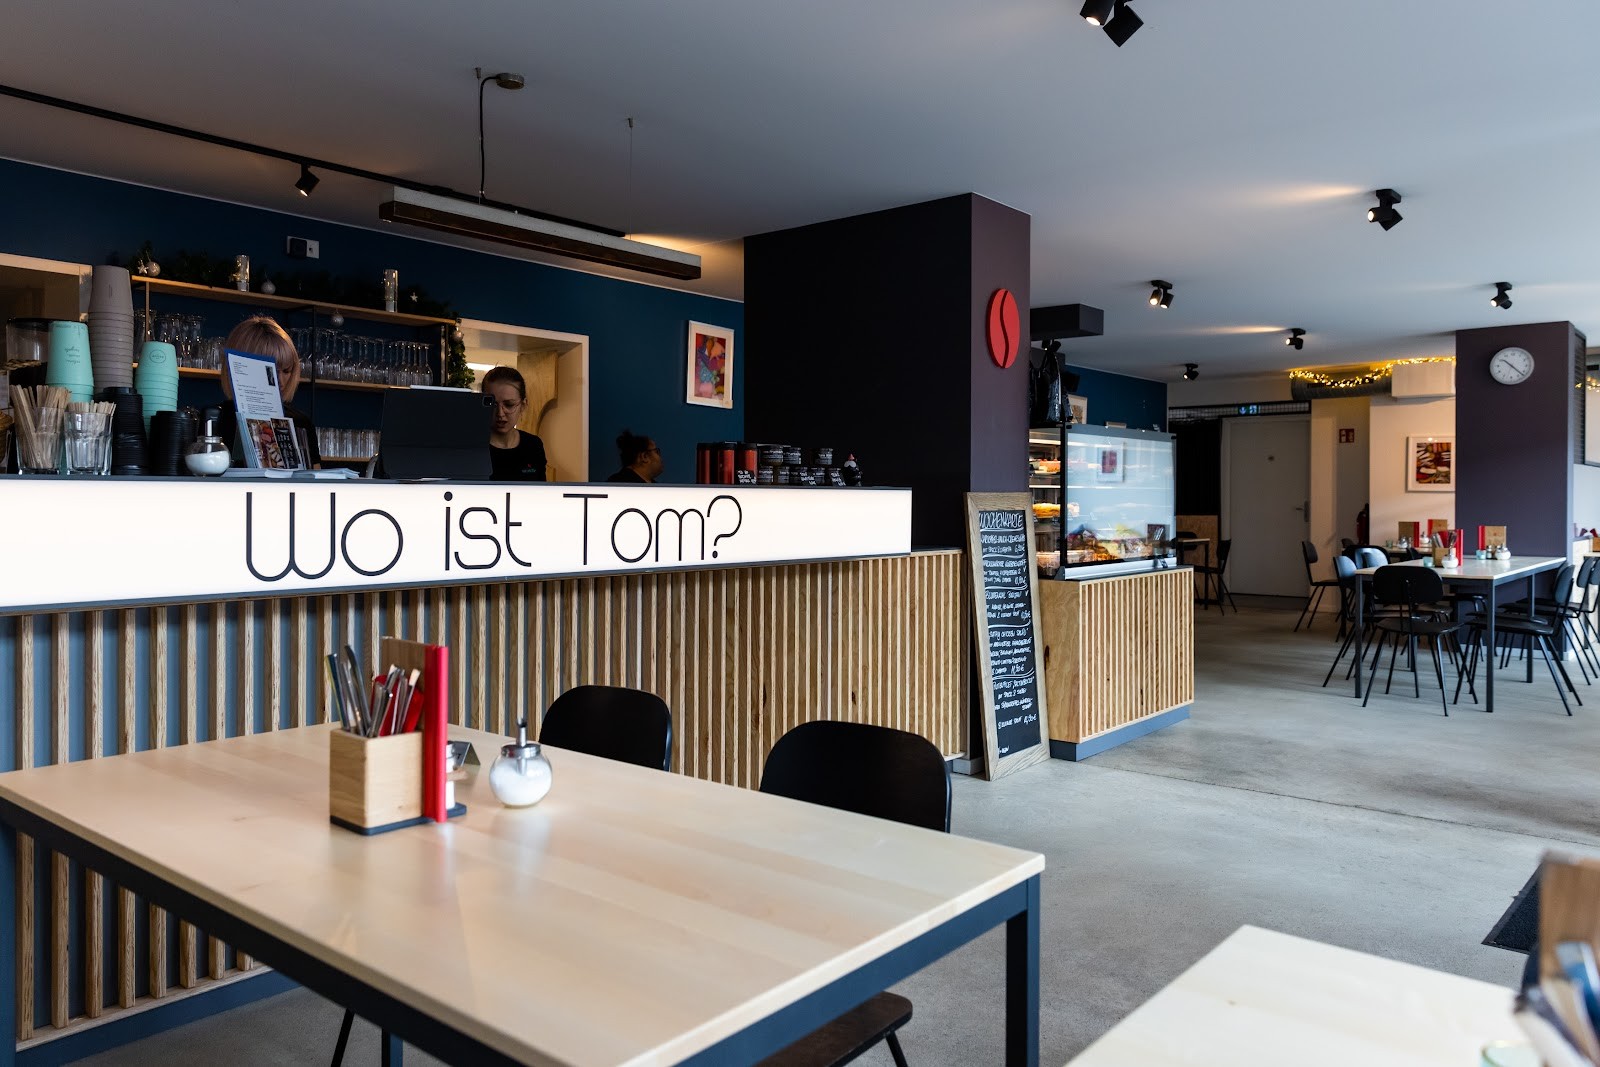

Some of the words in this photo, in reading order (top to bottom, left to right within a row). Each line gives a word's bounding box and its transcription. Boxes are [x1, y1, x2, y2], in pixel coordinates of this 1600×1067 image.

[246, 492, 403, 582] Wo
[444, 492, 531, 570] ist
[563, 494, 742, 565] Tom?
